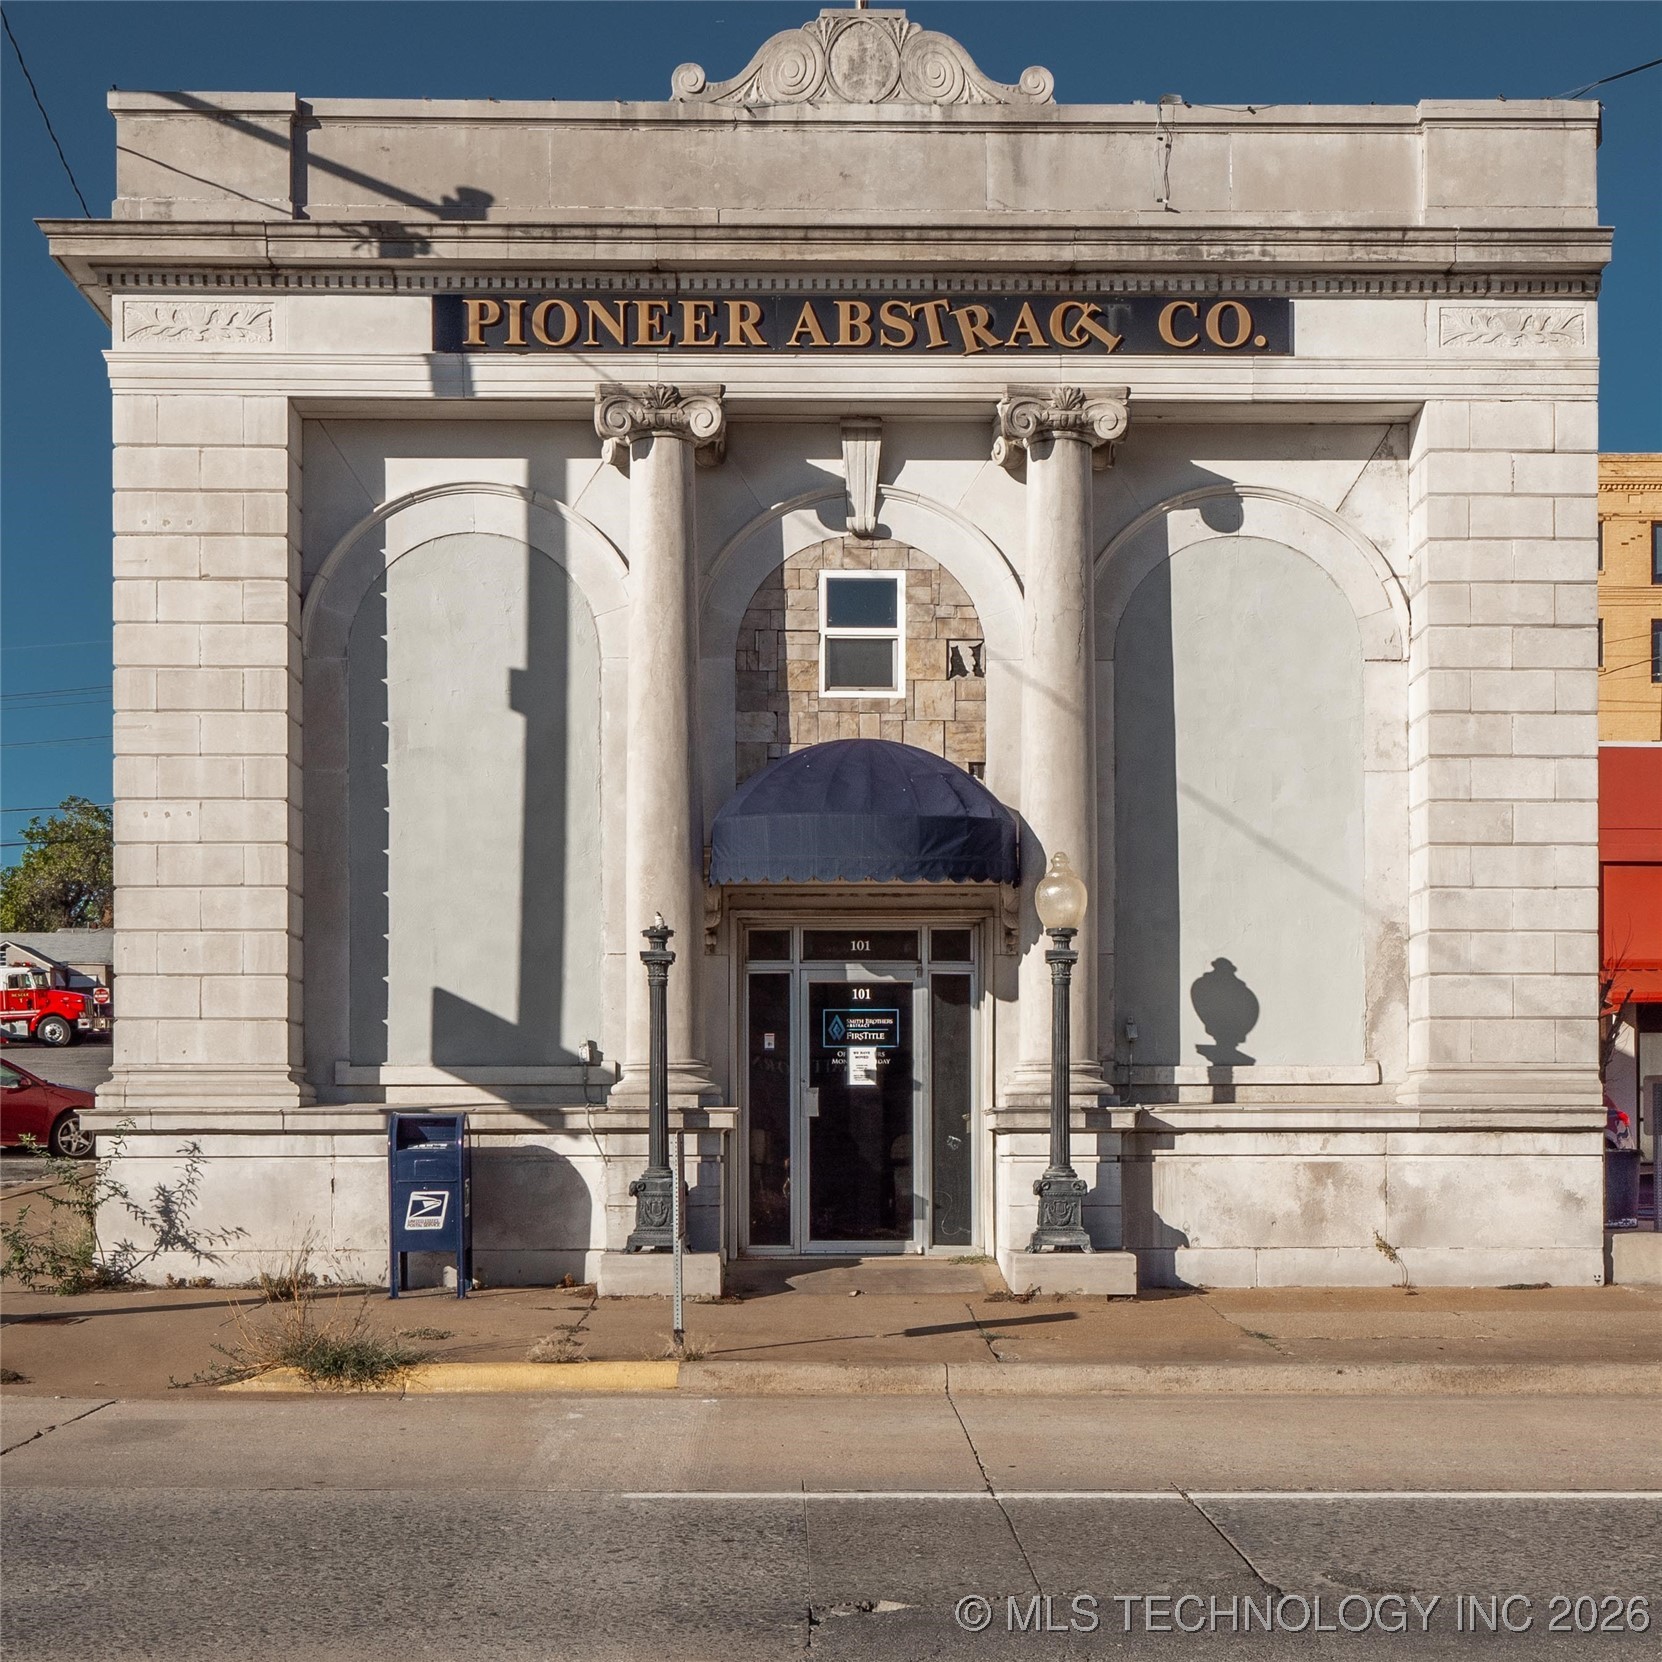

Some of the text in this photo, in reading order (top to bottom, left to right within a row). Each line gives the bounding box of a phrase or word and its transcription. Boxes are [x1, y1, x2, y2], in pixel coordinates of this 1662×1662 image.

[462, 299, 1267, 357] PIONEER ABSTRACT CO.
[850, 940, 871, 952] 101
[852, 988, 871, 1000] 101
